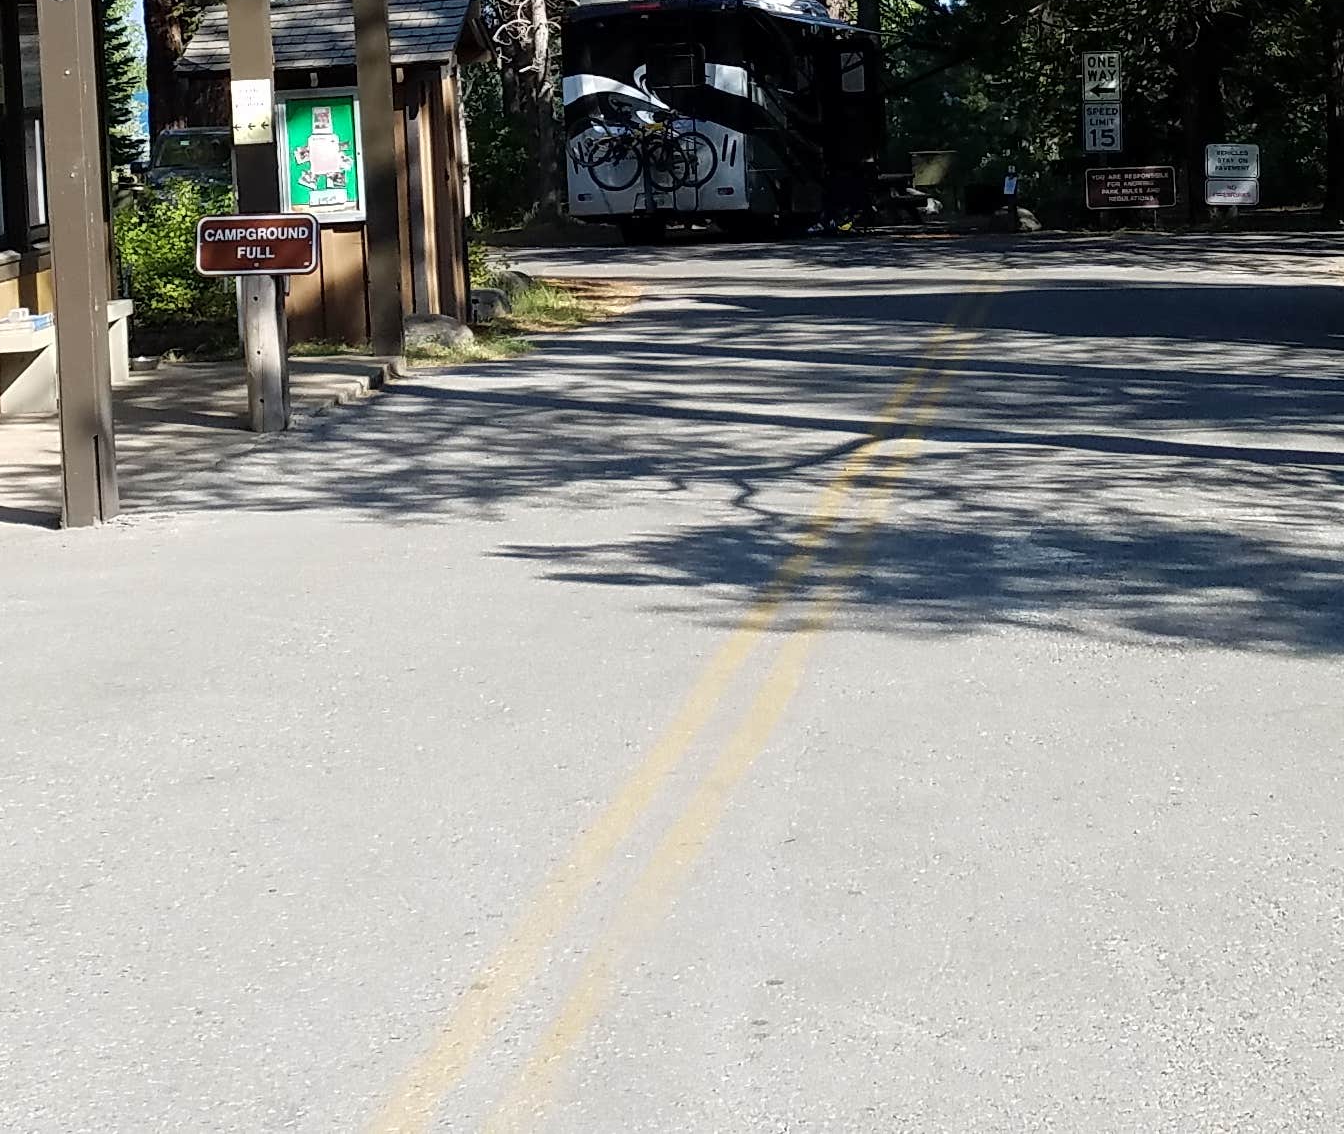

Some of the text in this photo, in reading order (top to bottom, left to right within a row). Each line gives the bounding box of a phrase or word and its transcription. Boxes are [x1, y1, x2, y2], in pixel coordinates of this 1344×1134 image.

[1087, 56, 1116, 68] ONE
[1087, 69, 1116, 82] WAY
[1086, 107, 1118, 116] SPEED
[1089, 118, 1116, 126] LIMIT
[1089, 128, 1116, 147] 15
[1124, 172, 1169, 180] RESPONSIBLE
[204, 226, 309, 242] CAMPGROUND
[236, 246, 275, 259] FULL
